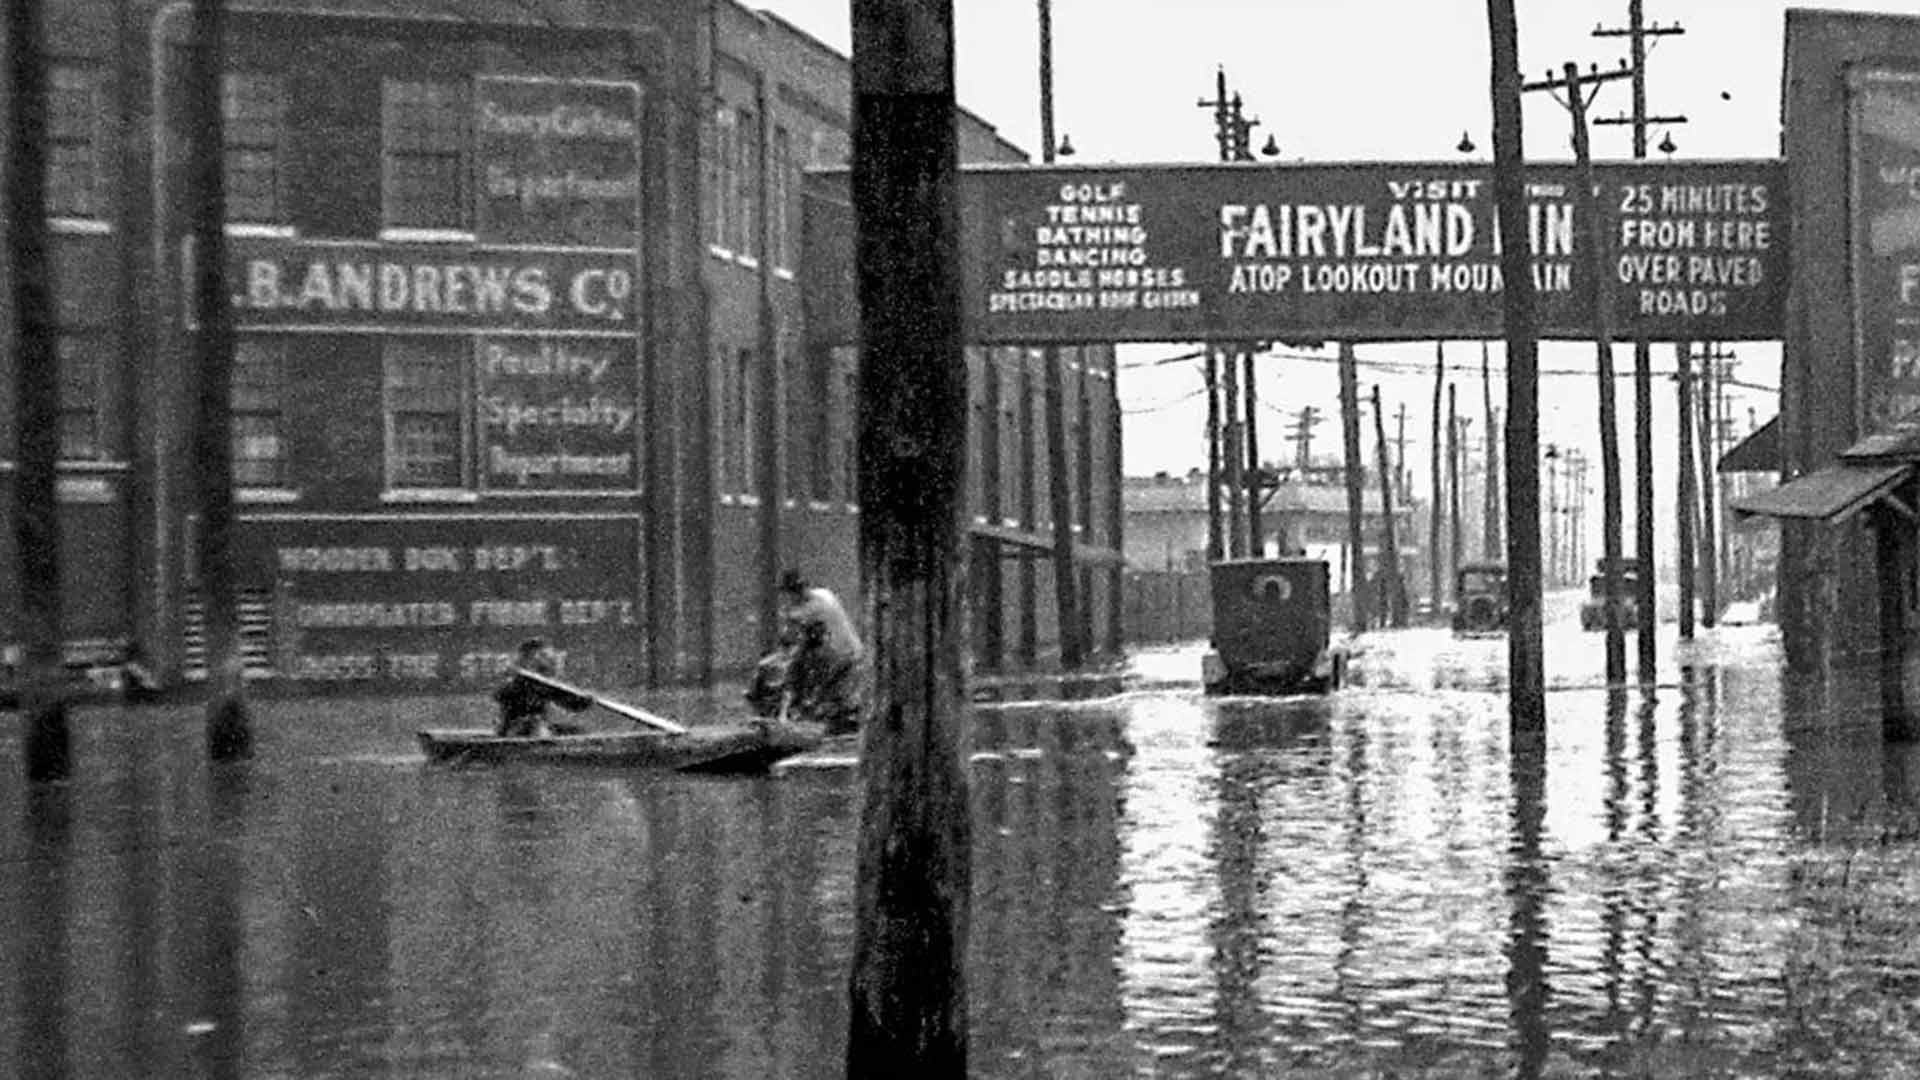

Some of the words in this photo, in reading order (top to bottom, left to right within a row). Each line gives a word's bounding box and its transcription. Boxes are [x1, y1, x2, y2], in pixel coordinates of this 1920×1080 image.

[1060, 183, 1126, 203] GOLF
[1388, 179, 1481, 199] VISIT
[1620, 185, 1653, 213] 25
[1661, 185, 1767, 213] MINUTES
[1046, 204, 1142, 224] TENNIS
[1036, 226, 1148, 245] BATHING
[1222, 203, 1474, 258] FAIRYLAND
[1622, 220, 1695, 248] FROM
[1704, 221, 1771, 249] HERE
[1037, 247, 1147, 266] DANCING
[1618, 253, 1681, 284] OVER
[1688, 255, 1764, 287] PAVED
[1003, 270, 1092, 290] SADDLE
[1098, 268, 1185, 288] HORSES
[1228, 264, 1292, 293] ATOP
[1302, 263, 1420, 292] LOOKOUT
[1430, 263, 1572, 292] MOUNIN
[1639, 289, 1728, 315] ROADS
[487, 345, 609, 382] Poultry
[478, 394, 634, 434] Specialty
